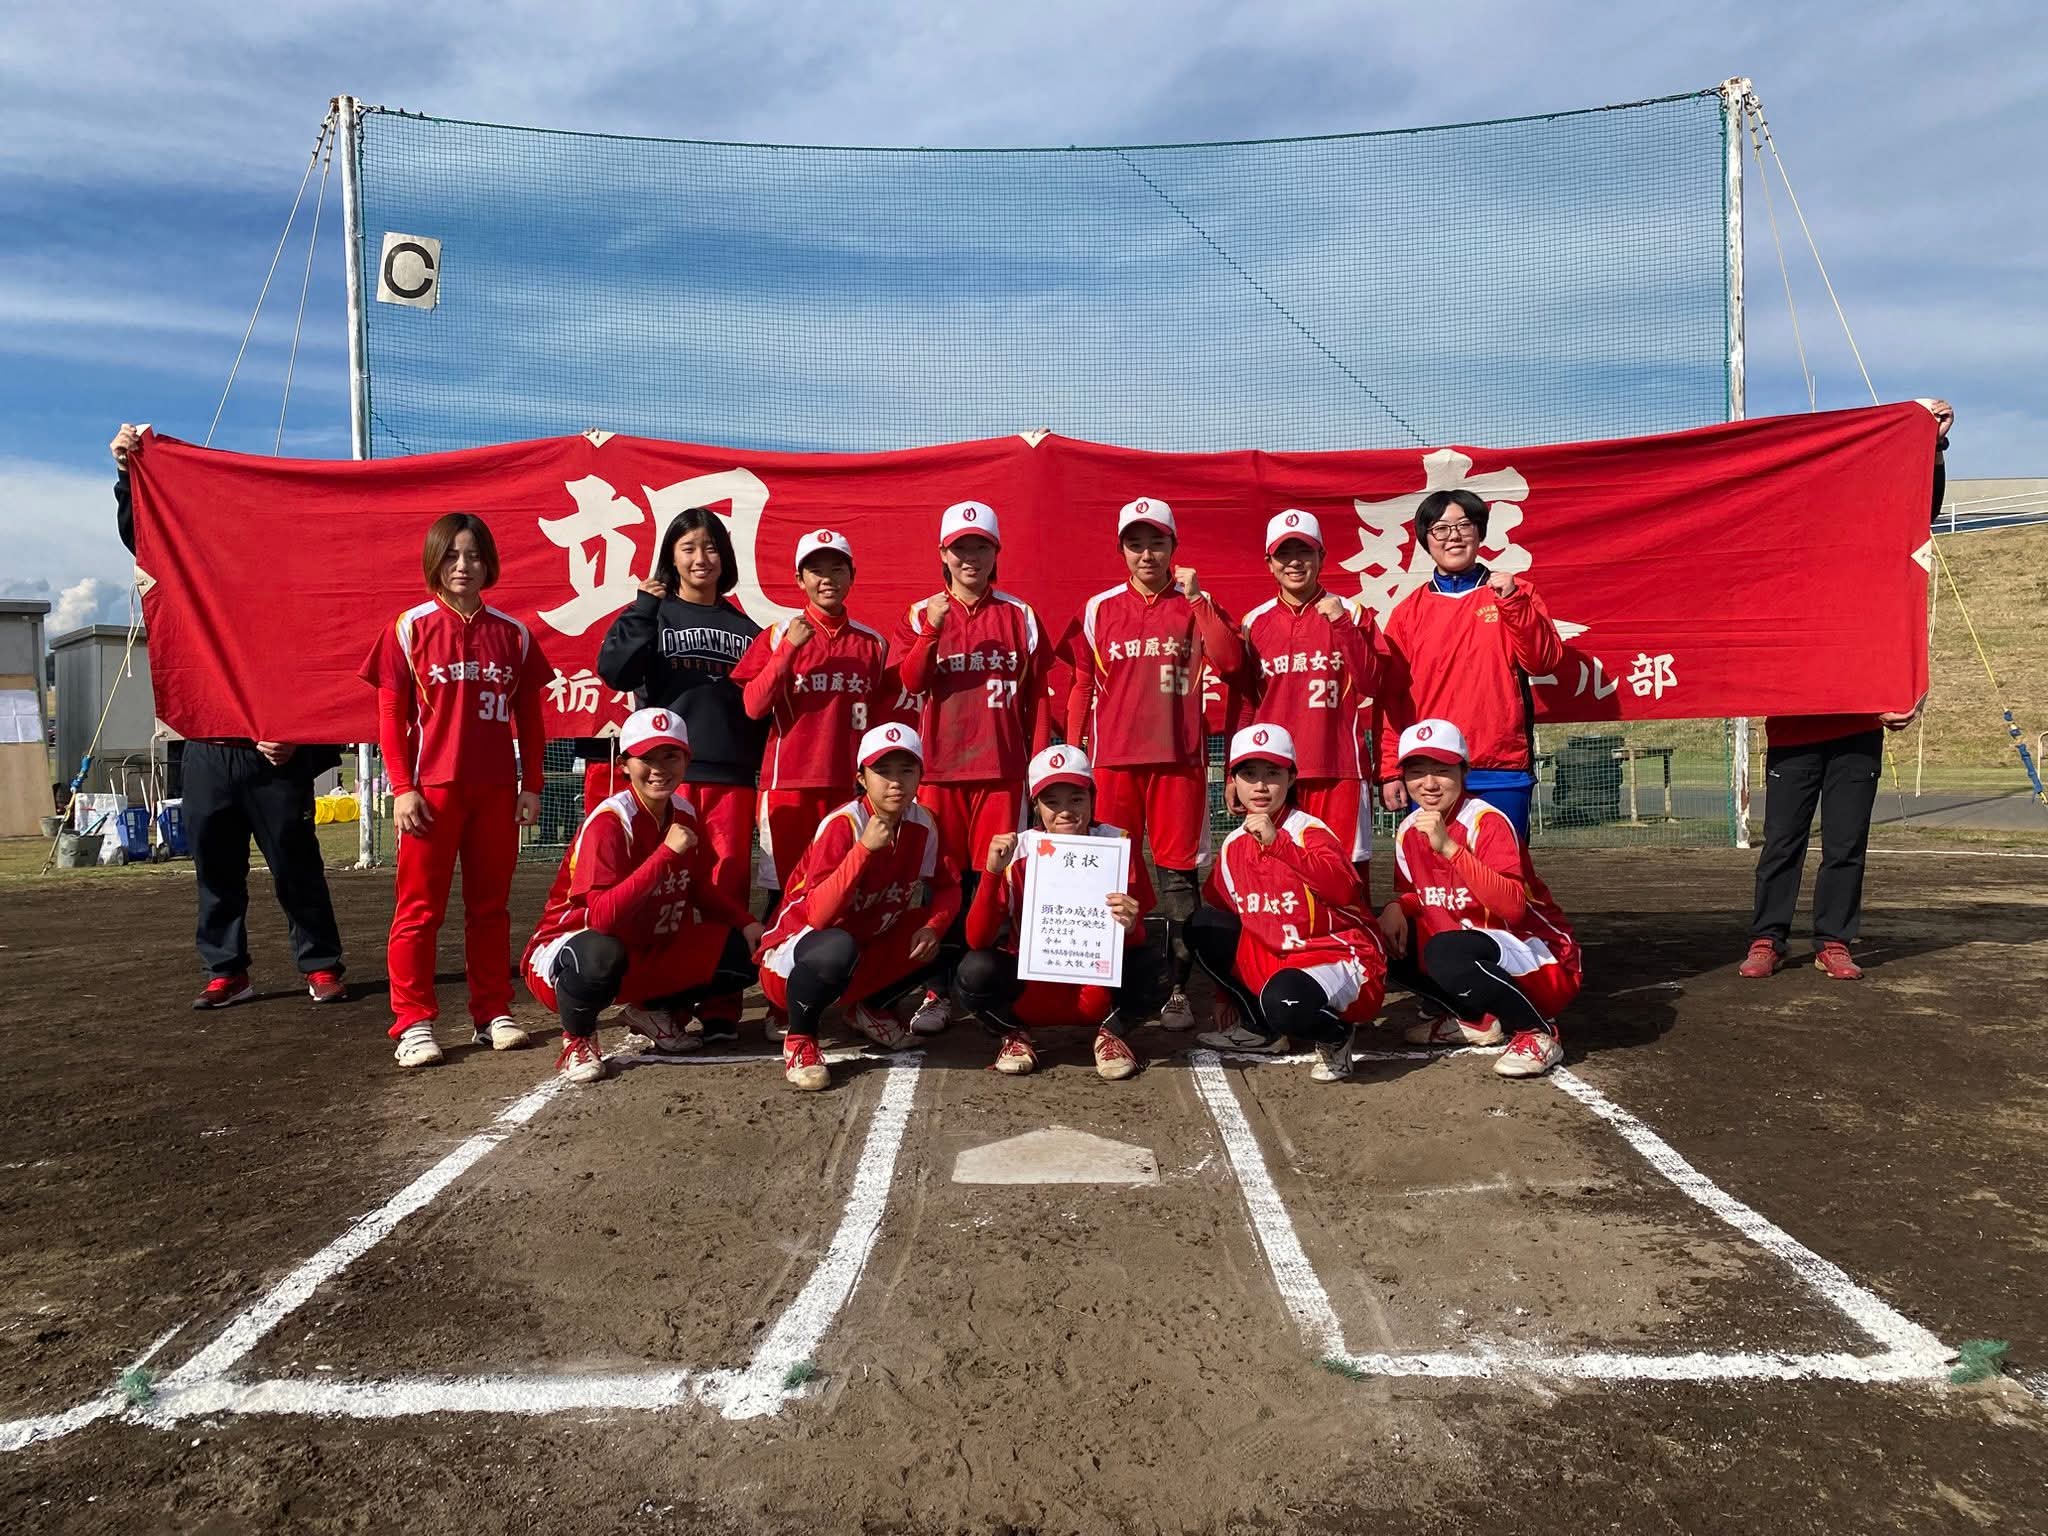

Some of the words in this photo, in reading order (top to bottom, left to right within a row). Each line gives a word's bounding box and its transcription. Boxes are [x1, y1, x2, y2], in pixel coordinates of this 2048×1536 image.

[384, 242, 434, 299] C
[427, 661, 514, 685] 大田原女子
[1159, 664, 1189, 695] 55
[986, 678, 1018, 709] 27
[1308, 679, 1339, 709] 23
[852, 702, 868, 730] 8
[1063, 851, 1100, 868] 賞状
